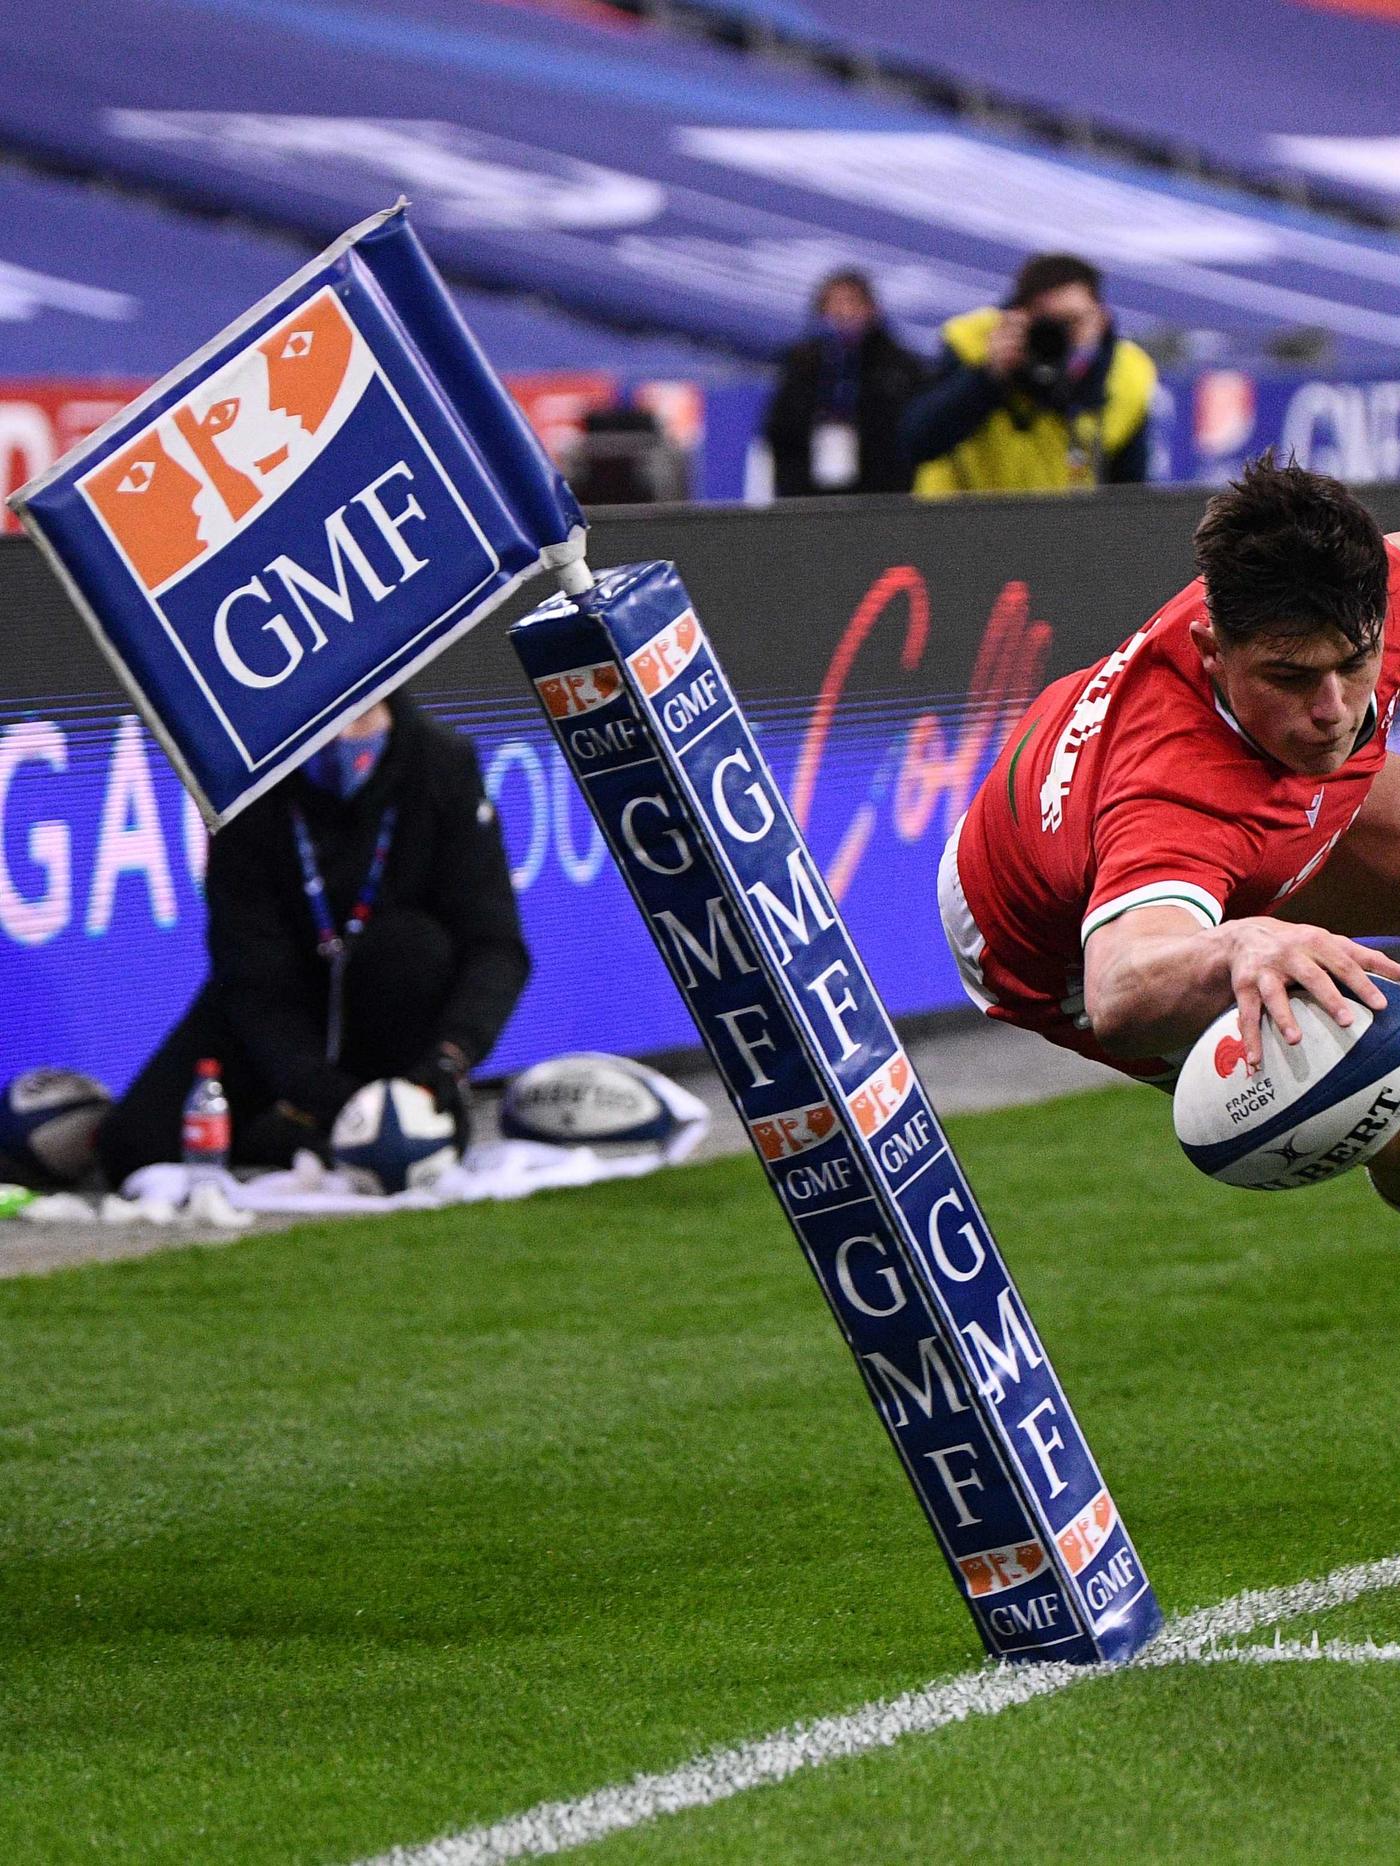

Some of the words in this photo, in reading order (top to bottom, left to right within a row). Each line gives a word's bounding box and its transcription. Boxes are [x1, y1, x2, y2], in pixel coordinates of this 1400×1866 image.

[213, 460, 430, 689] GMF
[664, 669, 719, 733] GMF
[570, 718, 637, 760] GMF
[712, 747, 862, 1062] GMF
[621, 795, 776, 1088] GMF
[1225, 1077, 1273, 1112] FRANCE
[1230, 1089, 1276, 1124] RUGBY
[880, 1109, 932, 1173] GMF
[785, 1157, 852, 1200] GMF
[928, 1188, 1069, 1498] GMF
[835, 1232, 985, 1527] GMF
[1086, 1547, 1136, 1611] GMF
[989, 1593, 1059, 1636] GMF
